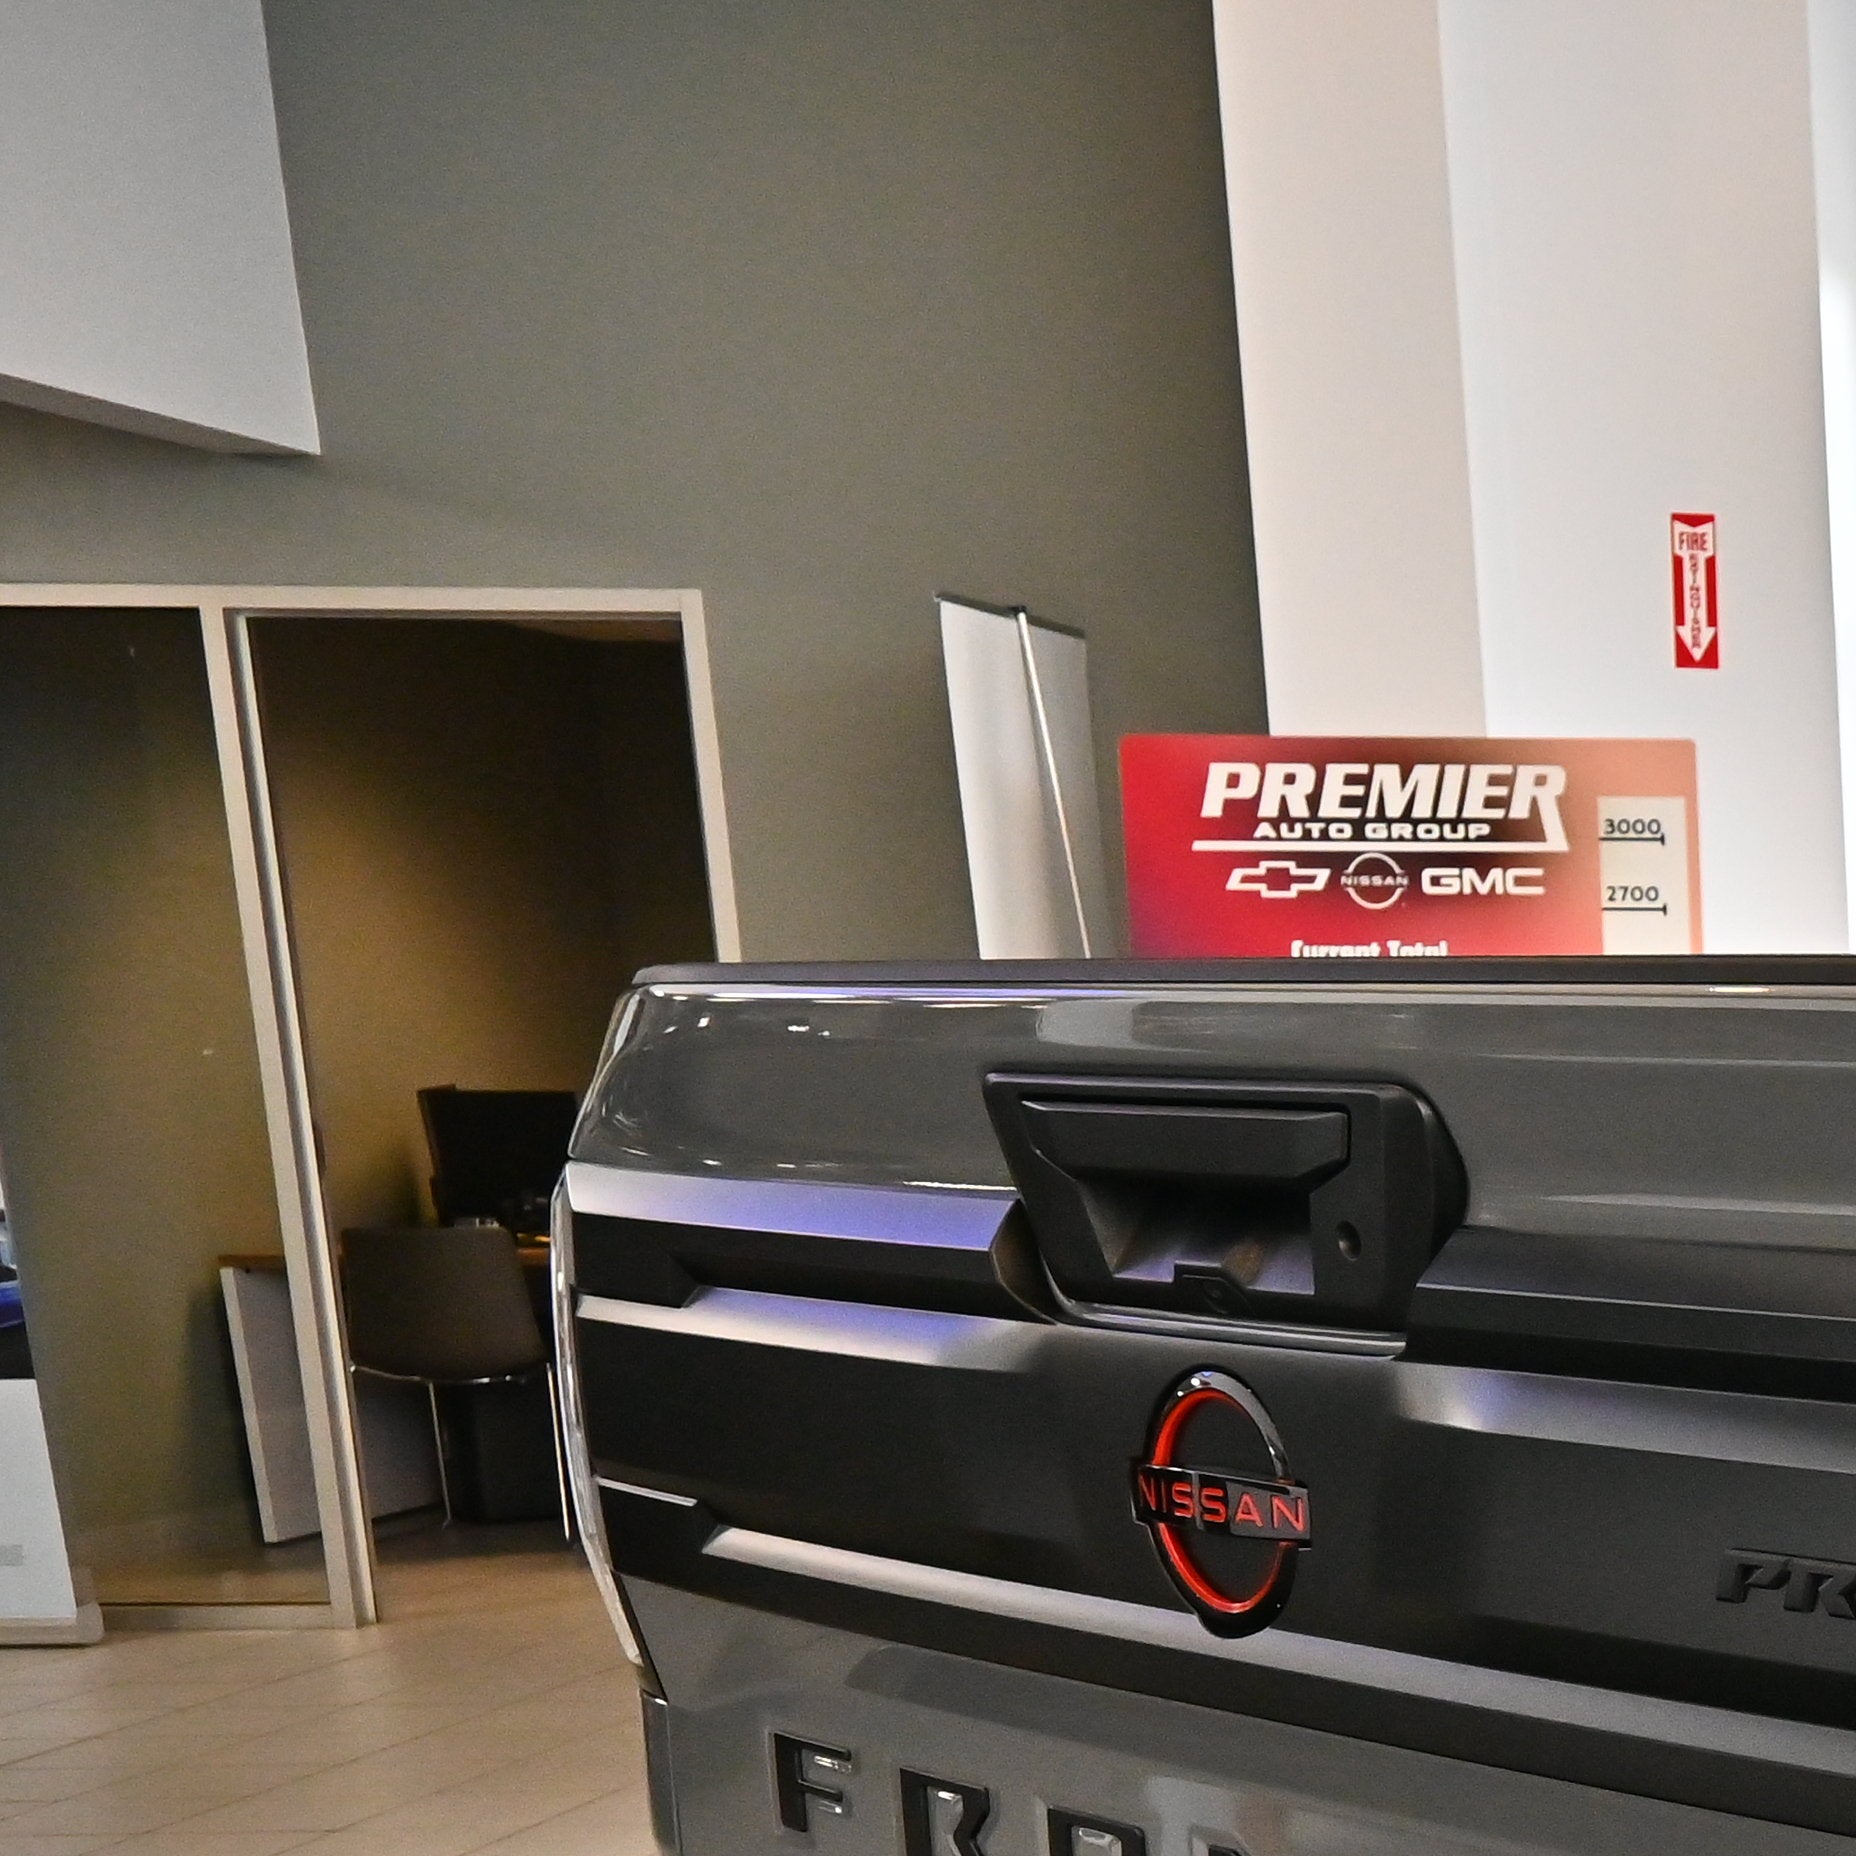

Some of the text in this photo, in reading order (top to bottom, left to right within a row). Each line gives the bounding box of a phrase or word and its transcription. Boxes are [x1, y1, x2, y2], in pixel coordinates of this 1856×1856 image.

[1678, 532, 1708, 551] FIRE
[1200, 763, 1567, 820] PREMIER
[1253, 822, 1492, 840] AUTO GROUP
[1603, 818, 1661, 835] 3000
[1340, 875, 1409, 887] NISSAN
[1421, 867, 1545, 895] GMC
[1606, 885, 1659, 902] 2700
[1137, 1470, 1306, 1532] NISSAN
